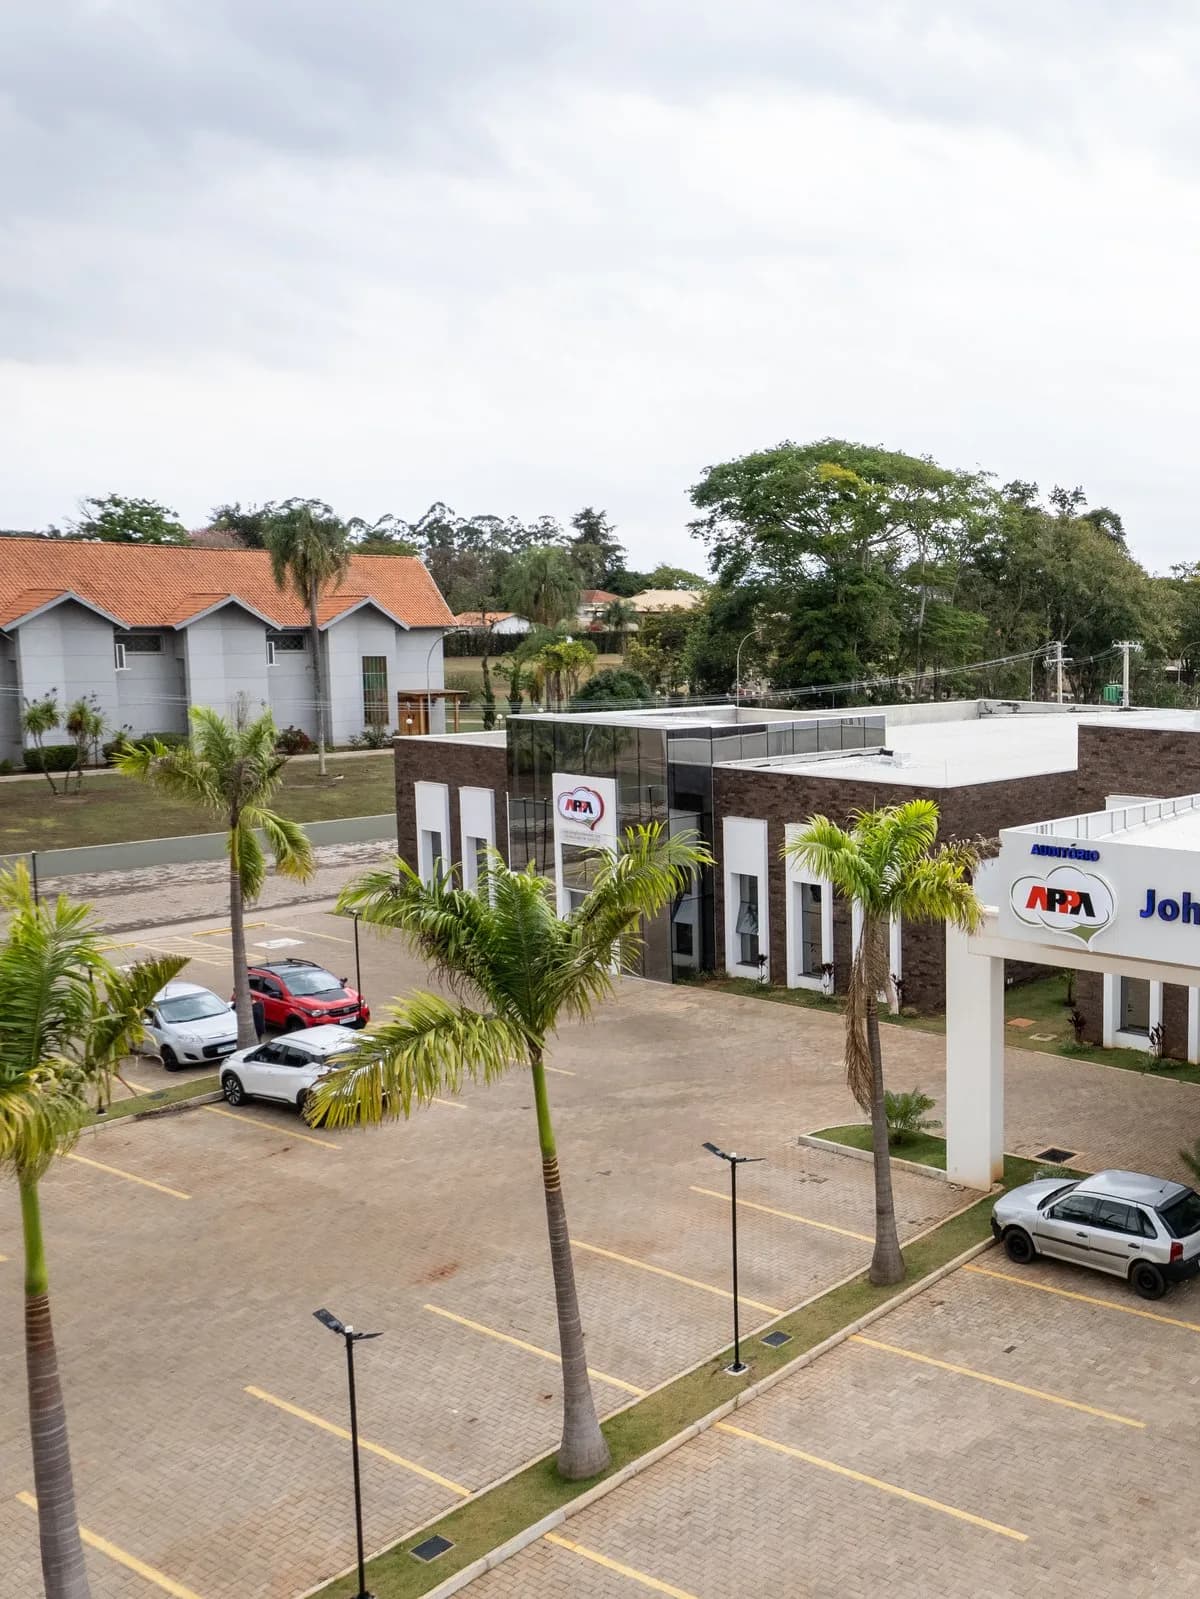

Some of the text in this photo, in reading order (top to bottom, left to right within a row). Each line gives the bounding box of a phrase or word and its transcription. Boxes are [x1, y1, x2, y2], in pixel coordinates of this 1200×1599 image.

[565, 799, 593, 814] APPA
[1031, 843, 1100, 862] AUDITÓRIO
[1025, 886, 1095, 917] APPA
